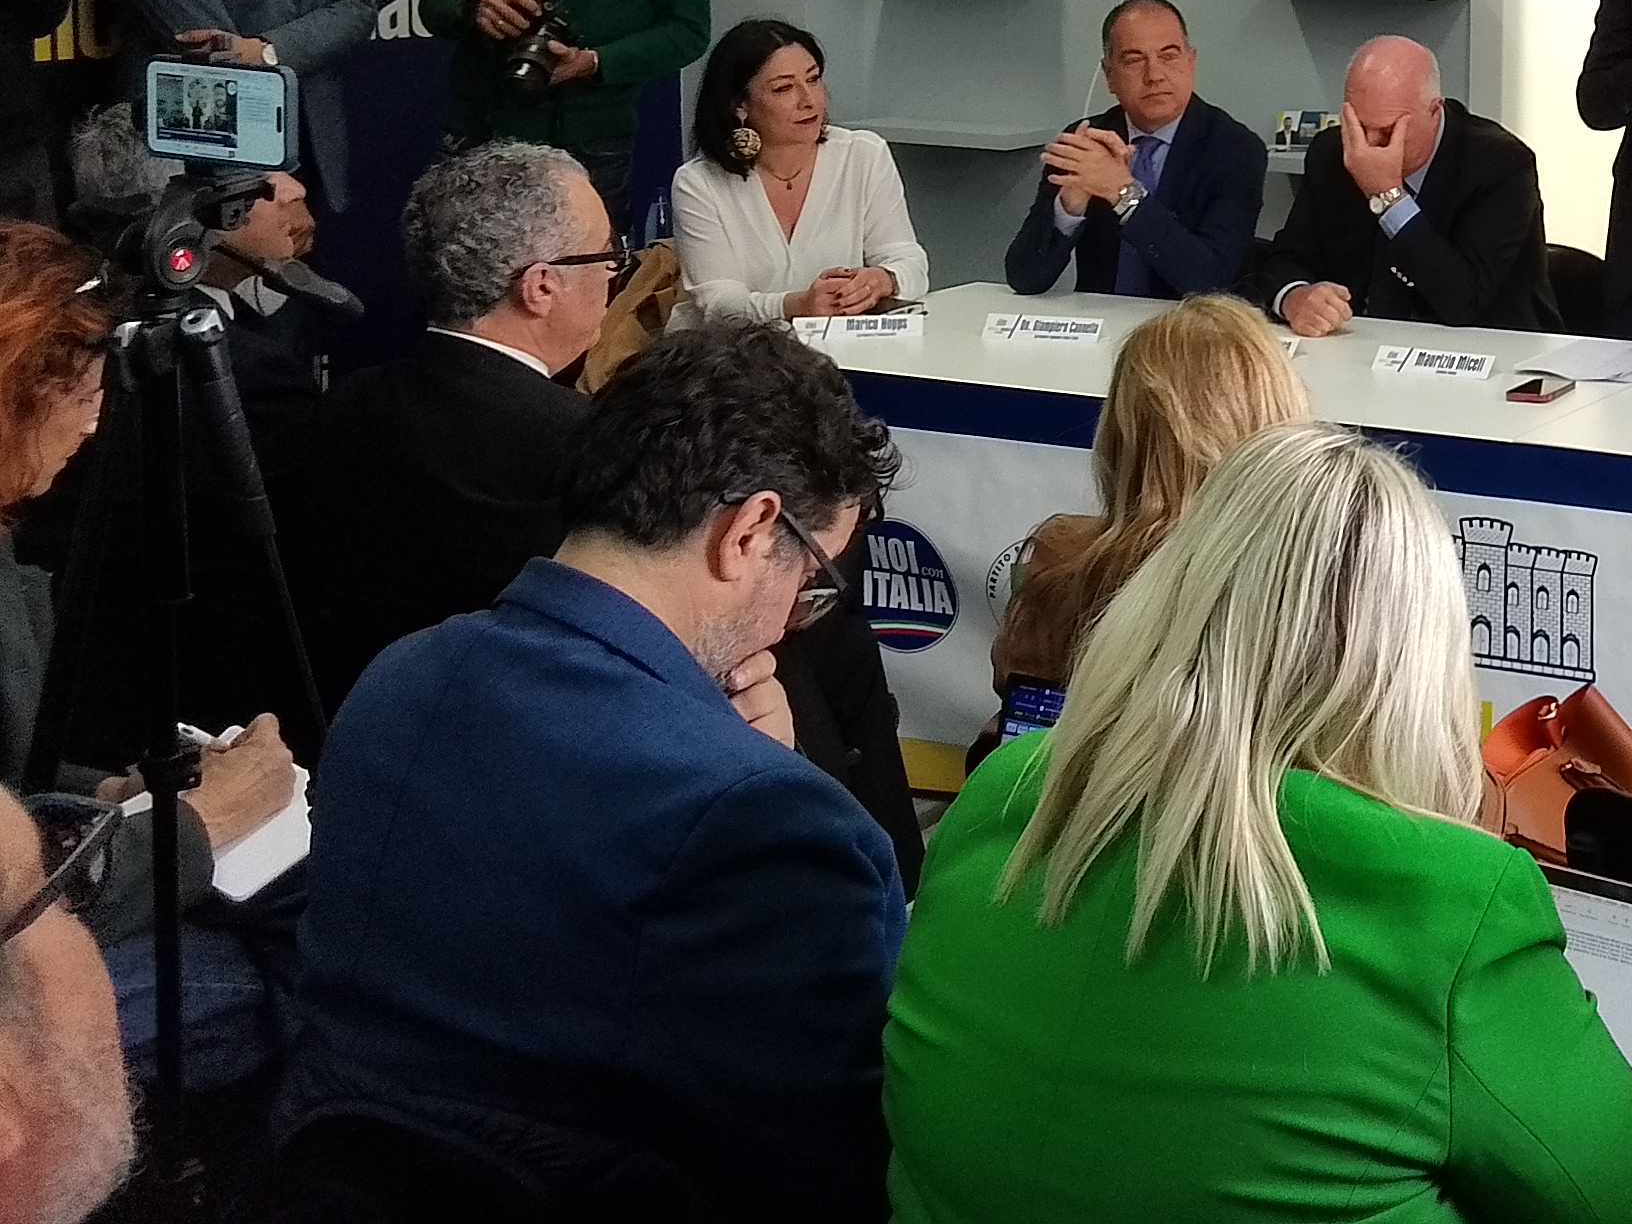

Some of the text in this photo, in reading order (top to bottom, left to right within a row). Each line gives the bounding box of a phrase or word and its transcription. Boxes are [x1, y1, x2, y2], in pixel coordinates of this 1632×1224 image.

[1415, 351, 1457, 369] Maurizio
[1456, 355, 1487, 372] Miceli
[867, 534, 944, 579] NOI con
[989, 552, 1011, 599] PARTITO
